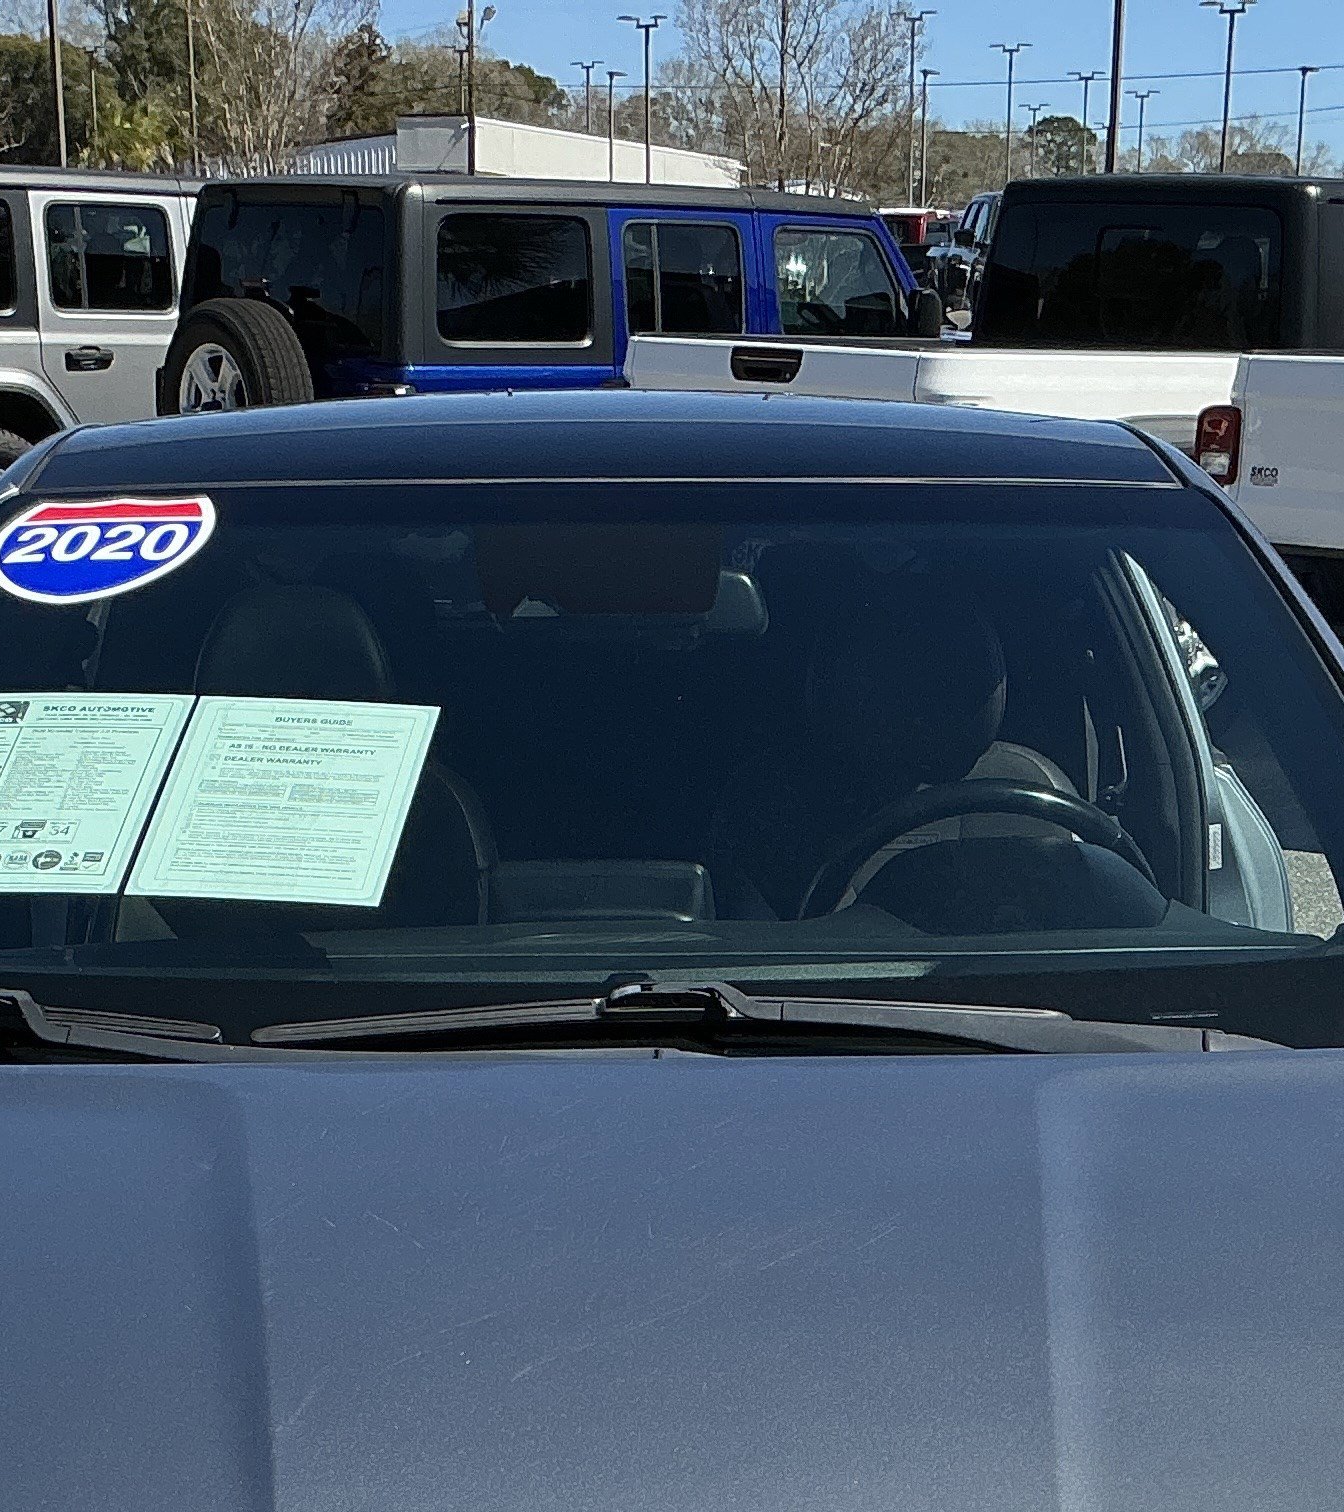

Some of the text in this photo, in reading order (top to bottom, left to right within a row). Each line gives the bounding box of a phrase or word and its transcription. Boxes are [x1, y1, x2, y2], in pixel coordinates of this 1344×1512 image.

[2, 523, 190, 564] 2020
[79, 706, 156, 714] AUTOMOTIVE
[274, 716, 353, 726] BUYERS GUIDE
[278, 745, 318, 753] DEALER
[320, 747, 377, 756] WARRANTY
[223, 755, 322, 766] DEALER WARRANTY
[49, 825, 71, 836] 34
